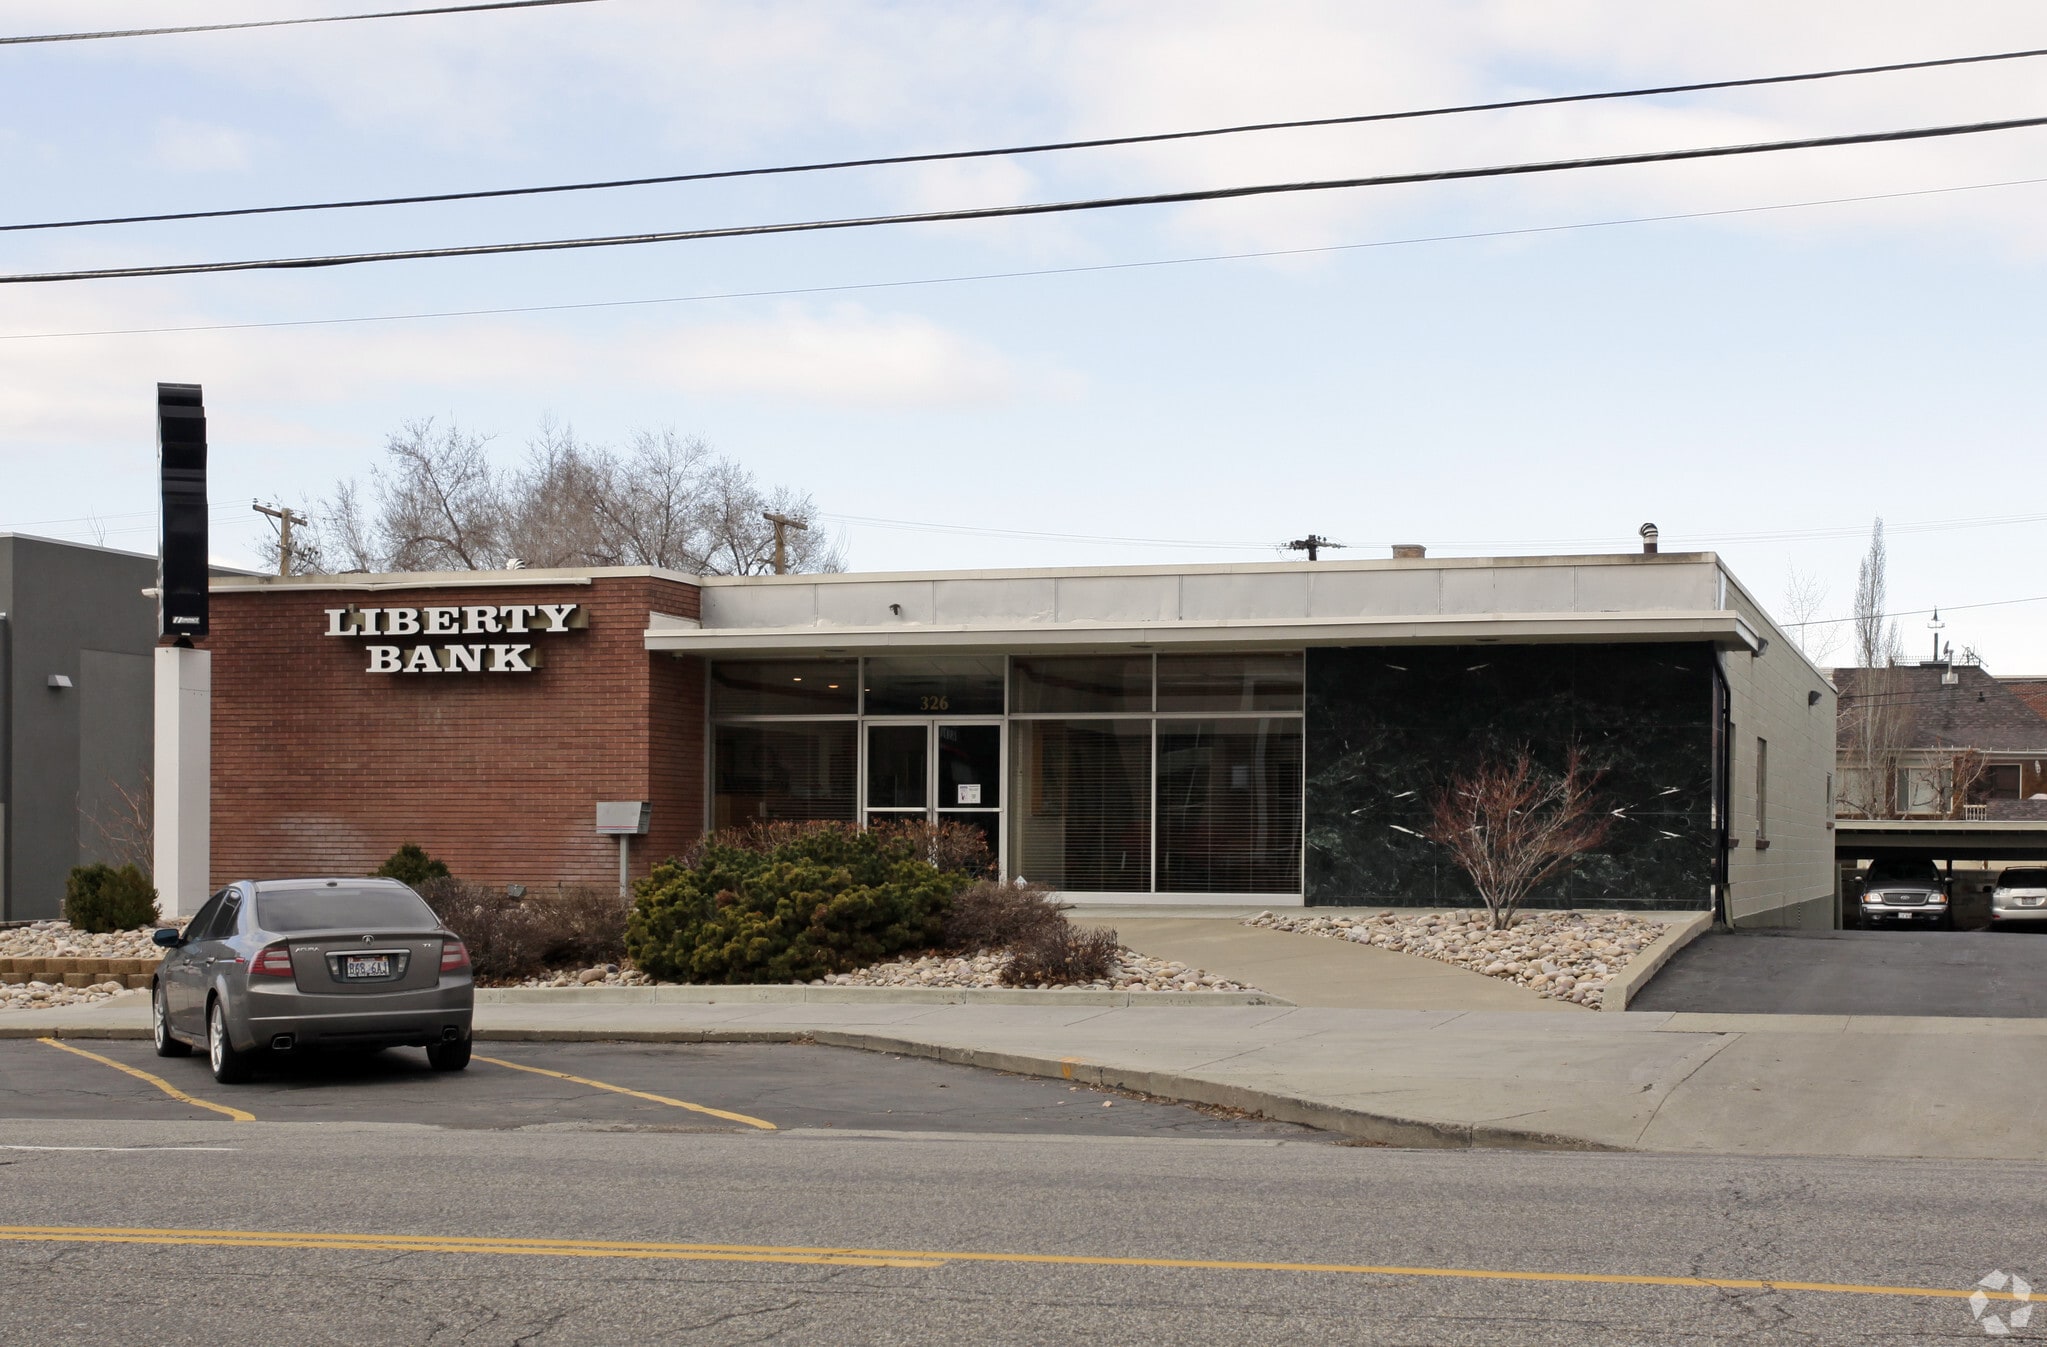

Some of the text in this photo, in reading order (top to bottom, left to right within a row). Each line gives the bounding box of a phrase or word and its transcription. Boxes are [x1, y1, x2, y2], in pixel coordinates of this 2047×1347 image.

[324, 604, 577, 636] LIBERTY
[365, 644, 532, 672] BANK
[920, 696, 949, 711] 326
